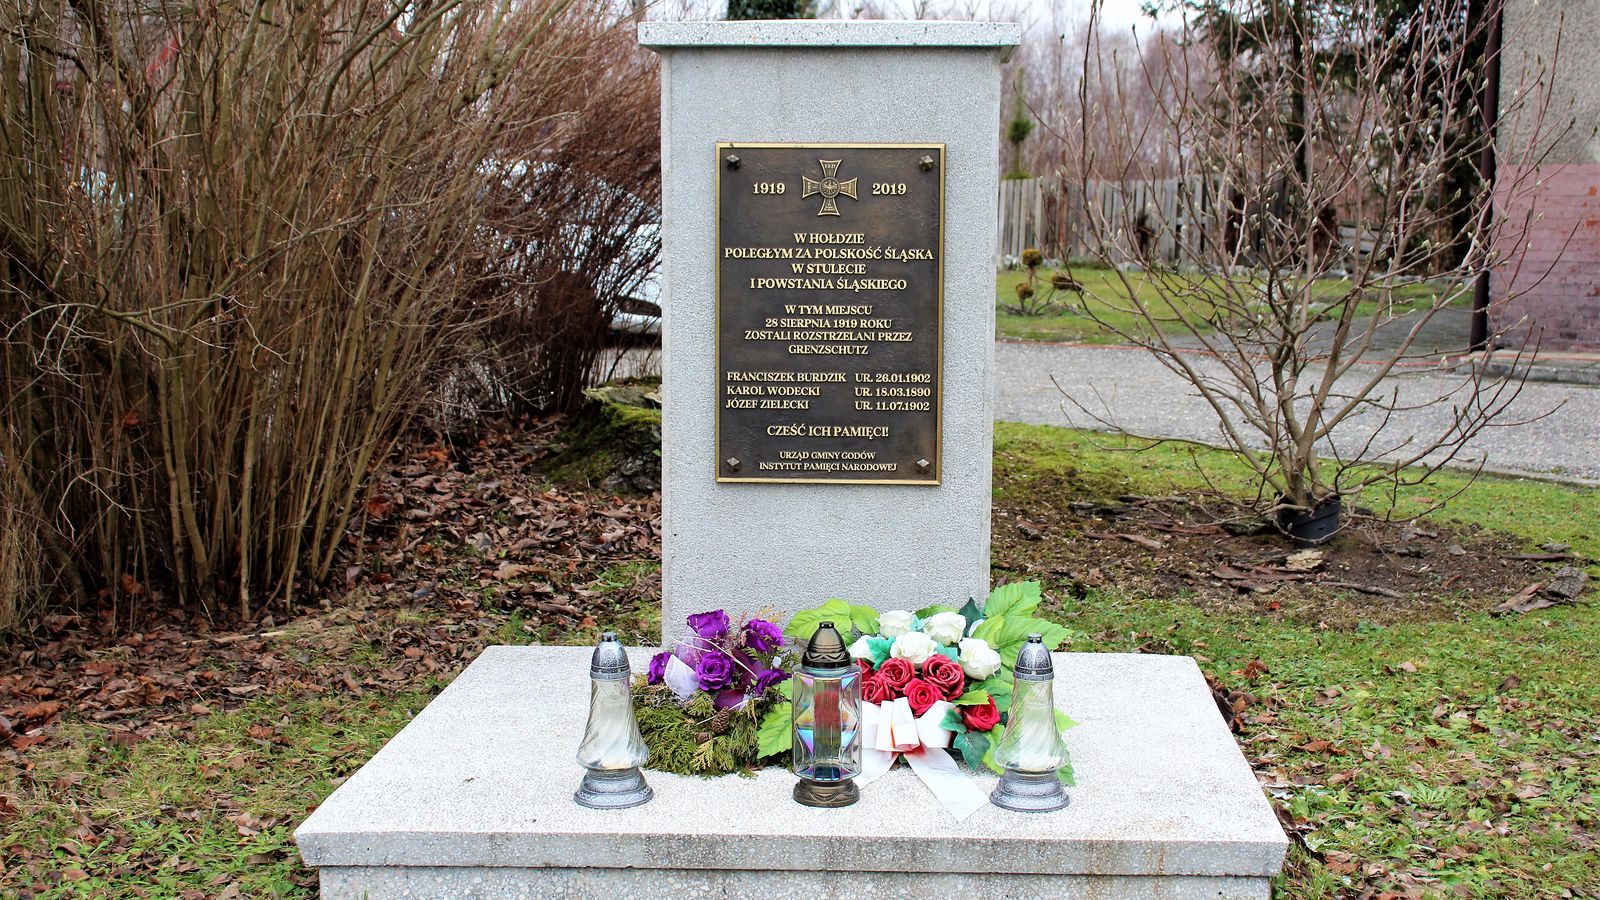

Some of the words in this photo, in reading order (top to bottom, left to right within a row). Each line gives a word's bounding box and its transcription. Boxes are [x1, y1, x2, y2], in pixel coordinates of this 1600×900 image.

[752, 182, 785, 195] 1919
[872, 183, 906, 196] 2019
[794, 233, 808, 244] W
[809, 233, 865, 244] HOŁDZIE
[725, 248, 793, 259] POLEGŁYM
[796, 249, 812, 259] ZA
[815, 247, 881, 260] POLSKOŚĆ
[884, 247, 934, 262] ŚLĄSKA
[792, 263, 805, 274] W
[807, 263, 866, 274] STULECIE
[750, 278, 755, 289] I
[758, 278, 834, 289] POWSTANIA
[837, 277, 907, 292] ŚLĄSKIEGO
[785, 305, 797, 315] W
[798, 305, 823, 315] TYM
[825, 305, 872, 315] MIEJSCU
[765, 319, 778, 328] 28
[780, 319, 830, 328] SIERPNIA
[833, 319, 857, 328] 1919
[860, 319, 892, 329] ROKU
[744, 331, 791, 340] ZOSTALI
[793, 331, 875, 341] ROZSTRZELANI
[878, 332, 912, 342] PRZEZ
[788, 345, 869, 355] GRENZSCHUTZ
[727, 372, 795, 382] FRANCISZEK
[797, 372, 846, 382] BURDZIK
[855, 374, 873, 383] UR.
[875, 374, 931, 383] 26.01.1902
[727, 386, 765, 395] KAROL
[767, 386, 820, 396] WODECKI
[855, 388, 872, 397] UR.
[875, 388, 931, 397] 18.03.1890
[725, 398, 758, 409] JÓZEF
[760, 400, 809, 409] ZIELECKI
[855, 401, 873, 410] UR.
[875, 401, 930, 411] 11.07.1902
[767, 424, 806, 436] CZEŚĆ
[808, 426, 831, 436] ICH
[834, 426, 889, 440] PAMIĘCI!
[779, 452, 809, 461] URZĄD
[811, 452, 840, 460] GMINY
[841, 451, 876, 460] GODÓW
[759, 462, 802, 470] INSTYTUT
[804, 463, 840, 473] PAMIĘCI
[842, 463, 897, 472] NARODOWEJ
